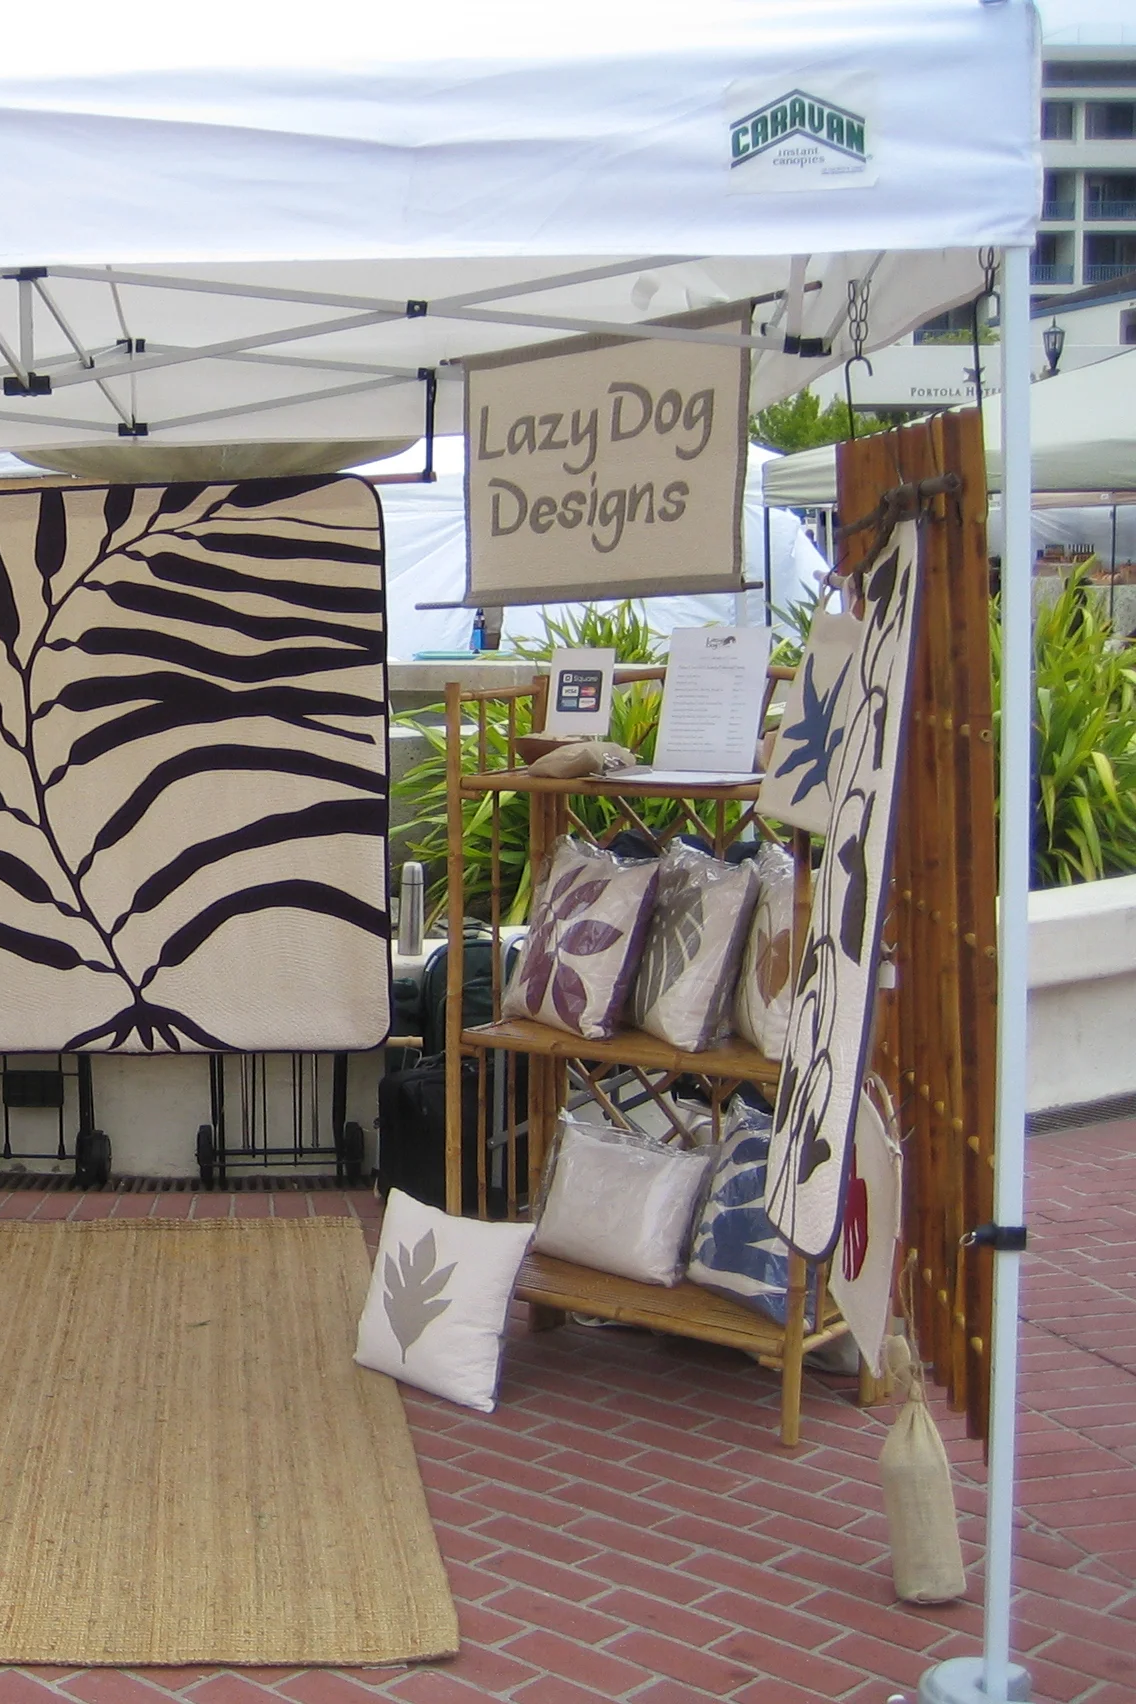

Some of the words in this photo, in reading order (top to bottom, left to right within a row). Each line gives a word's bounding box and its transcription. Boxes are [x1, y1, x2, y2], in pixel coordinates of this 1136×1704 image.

[731, 96, 865, 158] CARAVAN
[772, 156, 826, 168] canopies
[778, 147, 819, 156] instant
[910, 387, 961, 397] PORTOLA
[966, 386, 1002, 397] HTE
[477, 405, 598, 475] Lazy
[607, 381, 715, 461] Dog
[488, 471, 690, 553] Designs
